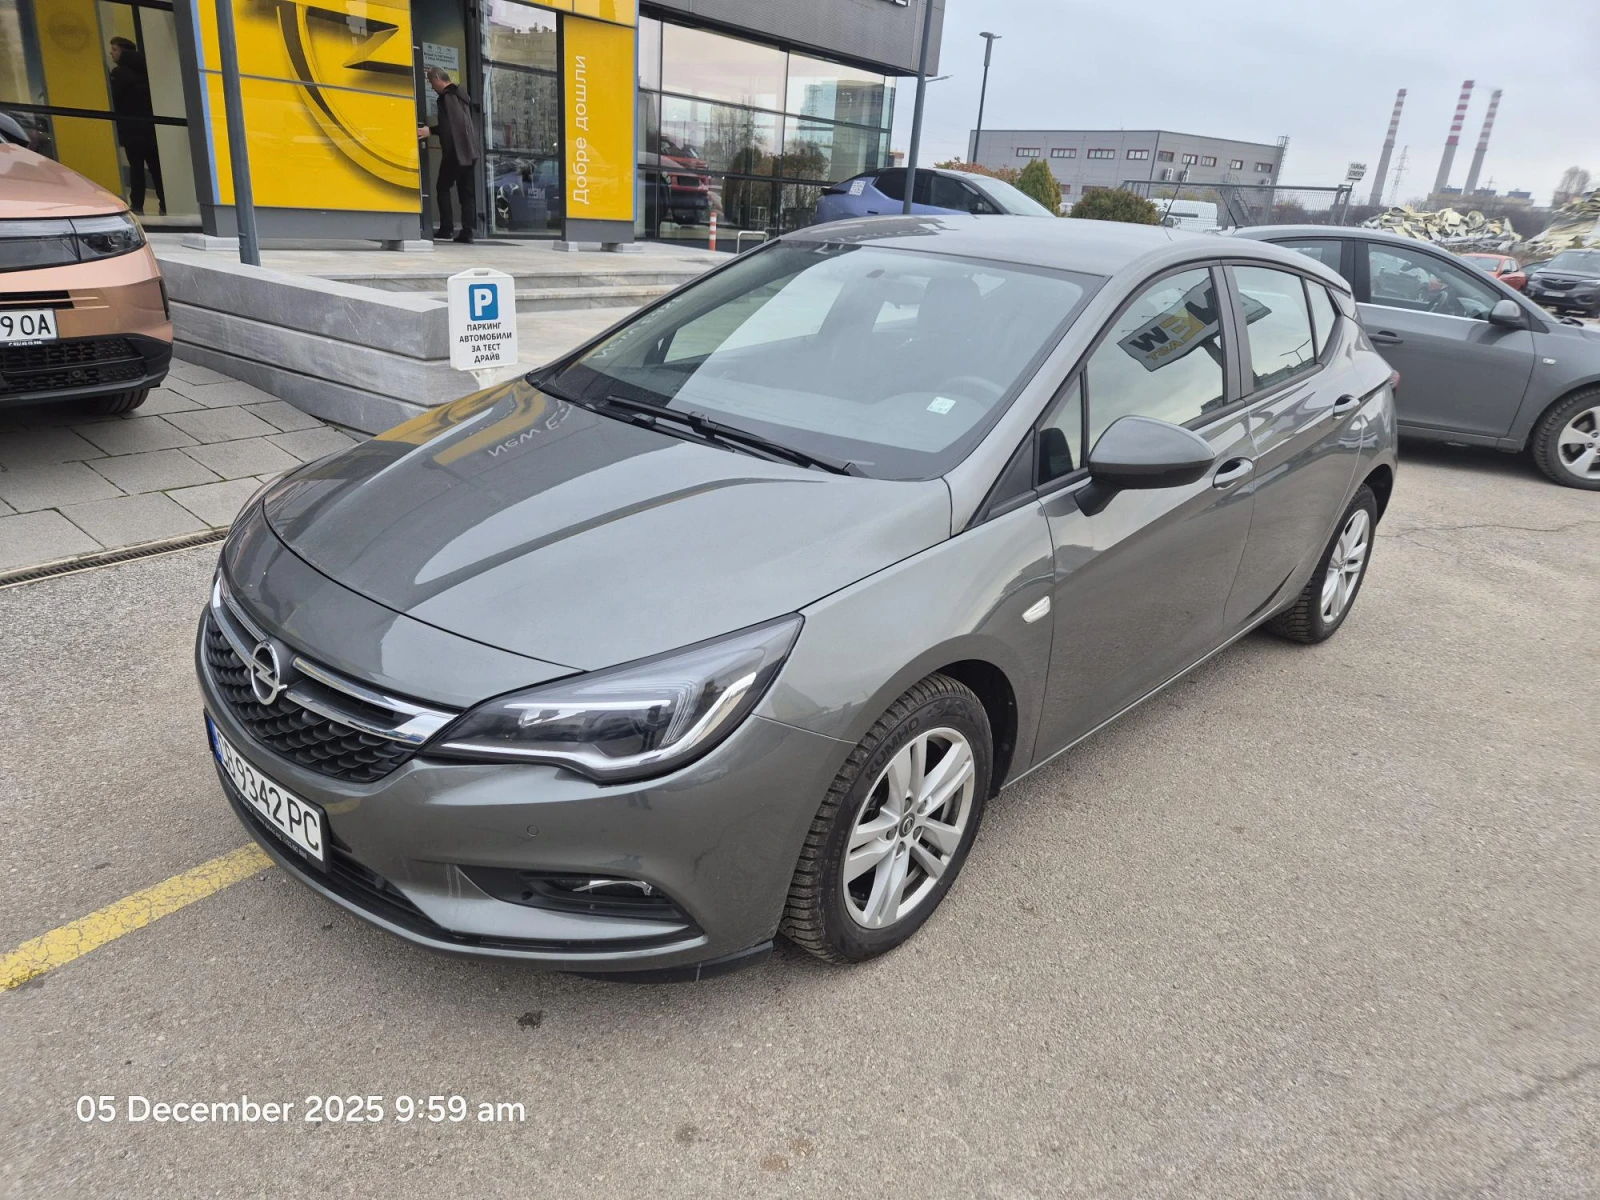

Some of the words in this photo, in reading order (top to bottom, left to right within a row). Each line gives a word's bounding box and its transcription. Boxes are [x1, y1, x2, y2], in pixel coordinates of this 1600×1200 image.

[575, 55, 589, 131] дошли
[573, 137, 590, 205] Добре
[473, 288, 493, 317] P
[466, 322, 502, 332] ПАРКИНГ
[459, 332, 512, 343] АВТОМОБИЛИ
[471, 345, 481, 353] ЗА
[483, 343, 501, 352] ТЕСТ
[474, 352, 500, 364] ДРАЙВ
[865, 717, 920, 780] KUMHO
